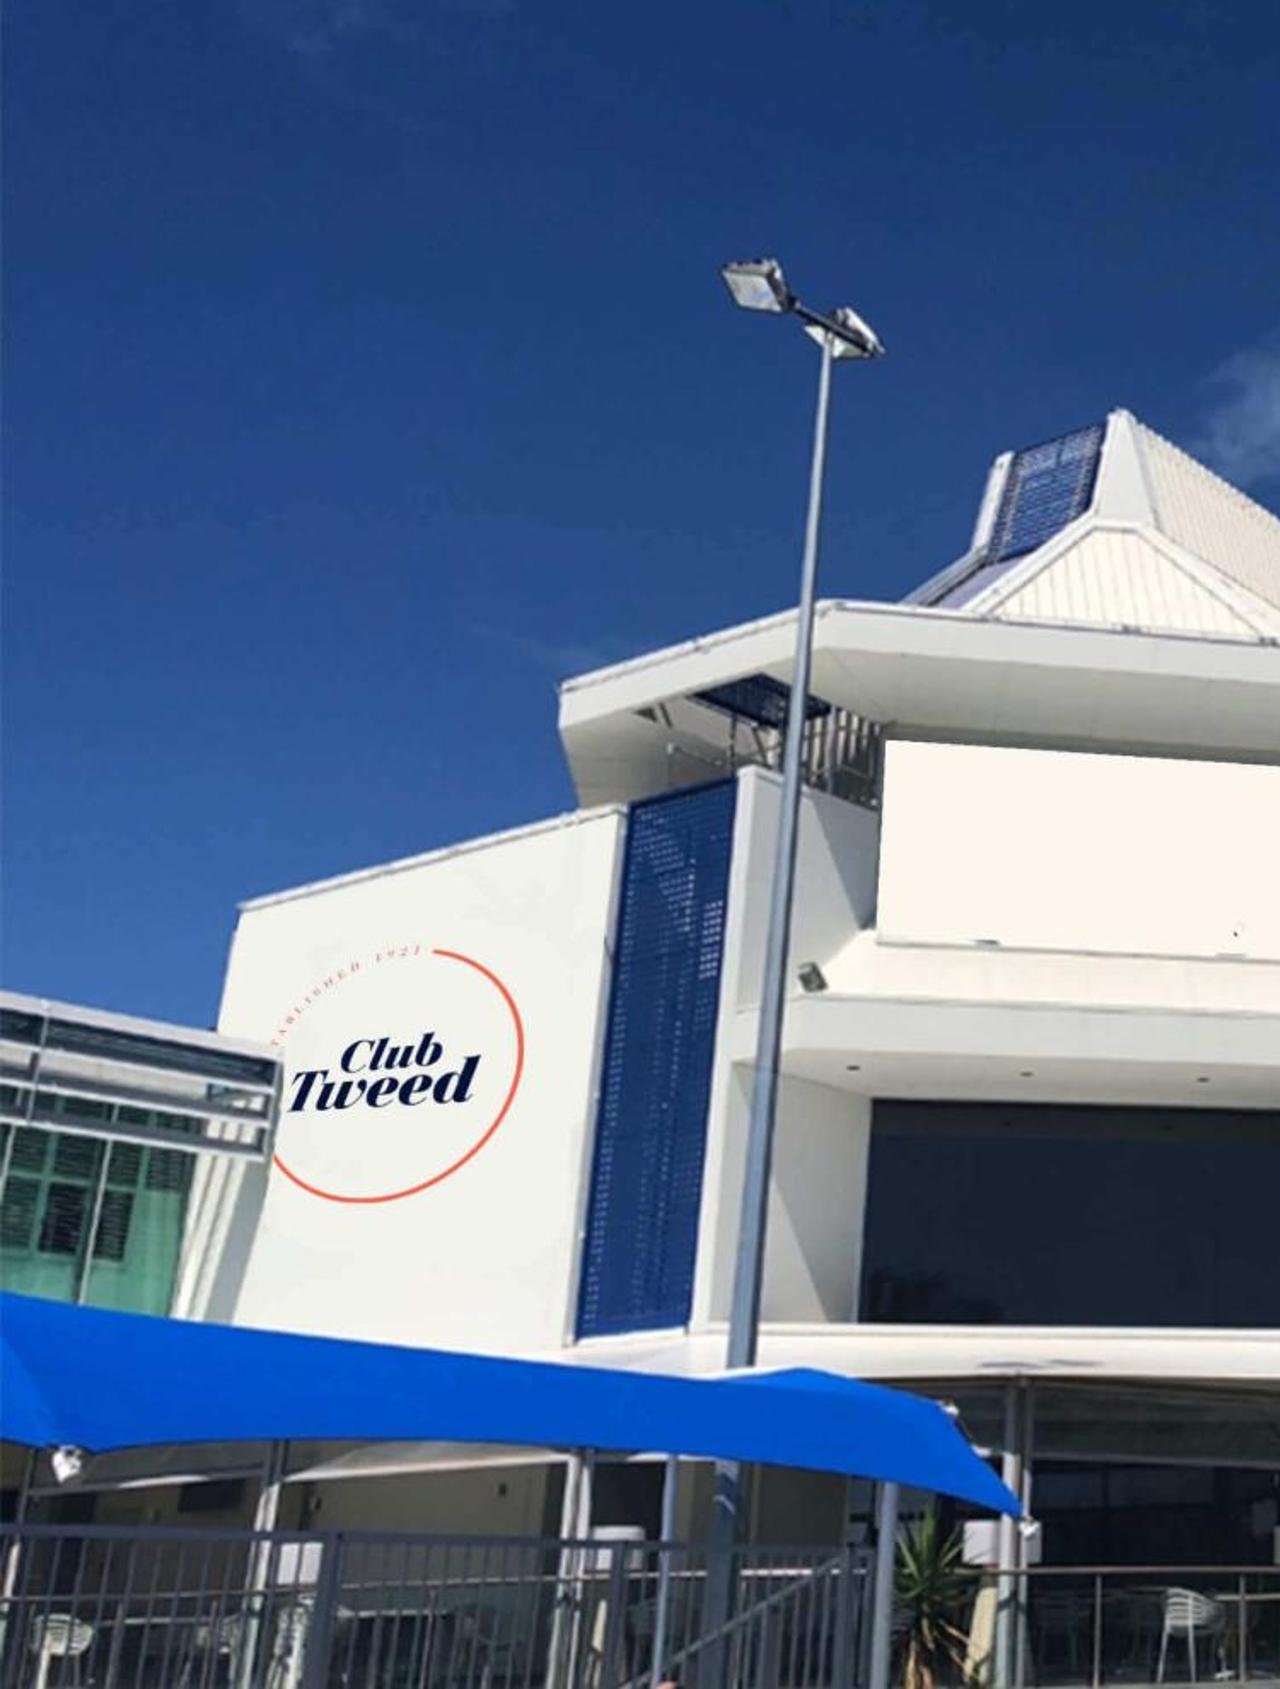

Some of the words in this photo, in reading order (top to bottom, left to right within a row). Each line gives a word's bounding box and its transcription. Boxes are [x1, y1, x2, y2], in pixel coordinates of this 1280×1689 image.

[270, 961, 361, 1047] TABLISHED
[340, 1031, 444, 1074] Club
[287, 1054, 482, 1113] Tweed
